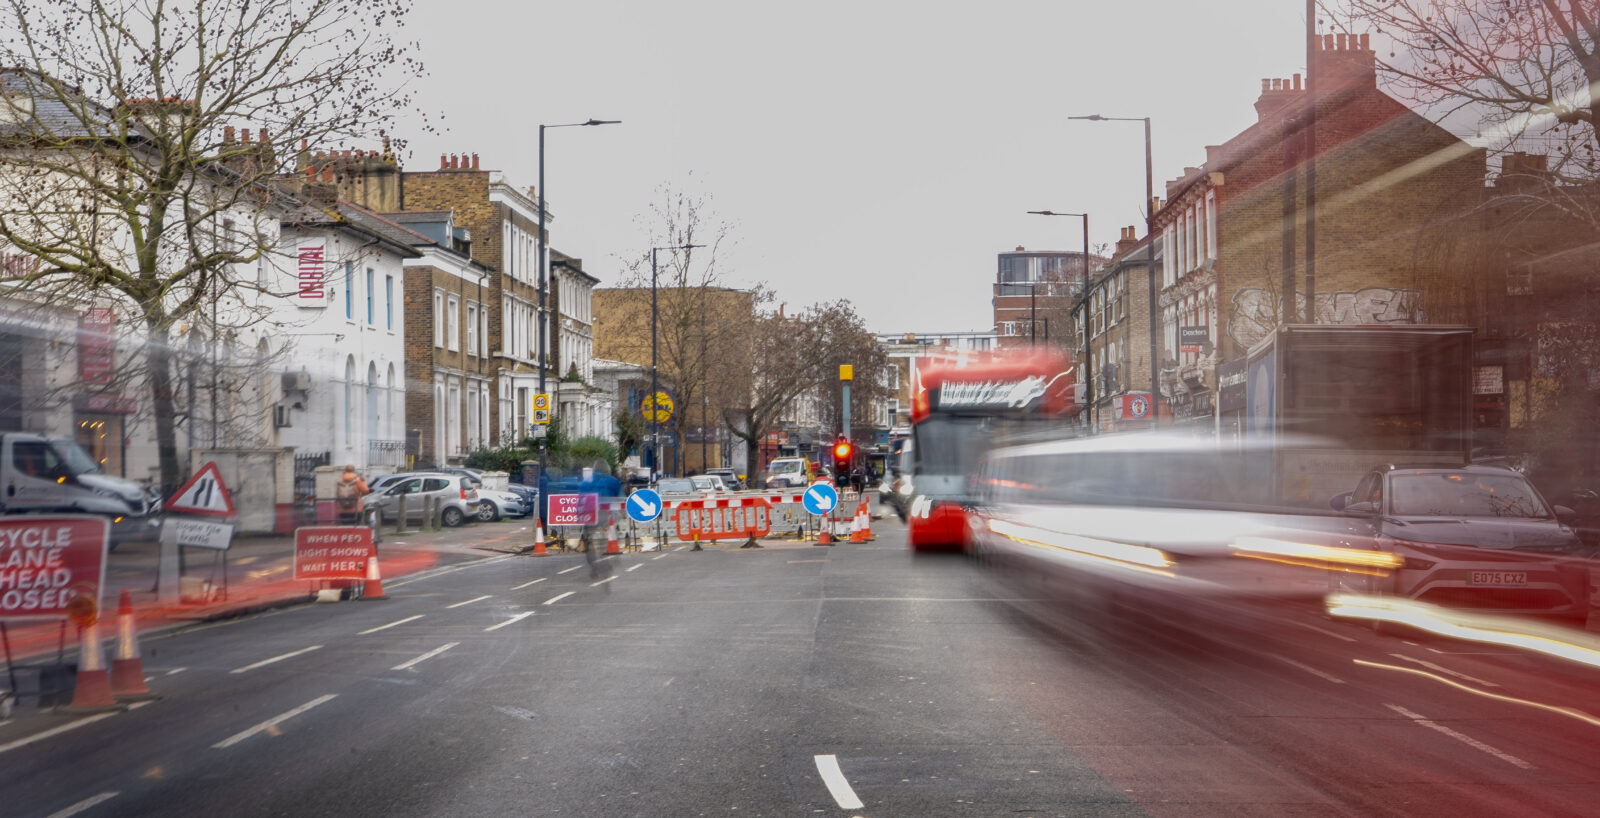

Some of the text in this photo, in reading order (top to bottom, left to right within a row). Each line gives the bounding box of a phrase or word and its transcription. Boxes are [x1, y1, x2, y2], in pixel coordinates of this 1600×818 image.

[298, 245, 324, 298] ORBITAL
[306, 534, 338, 543] WHEN
[0, 548, 63, 569] ANE
[299, 547, 369, 558] LIGHT SHOWS
[302, 561, 364, 572] WAIT HERE
[0, 567, 72, 589] HEAD
[1504, 573, 1525, 584] CXZ
[0, 588, 77, 610] OSED
